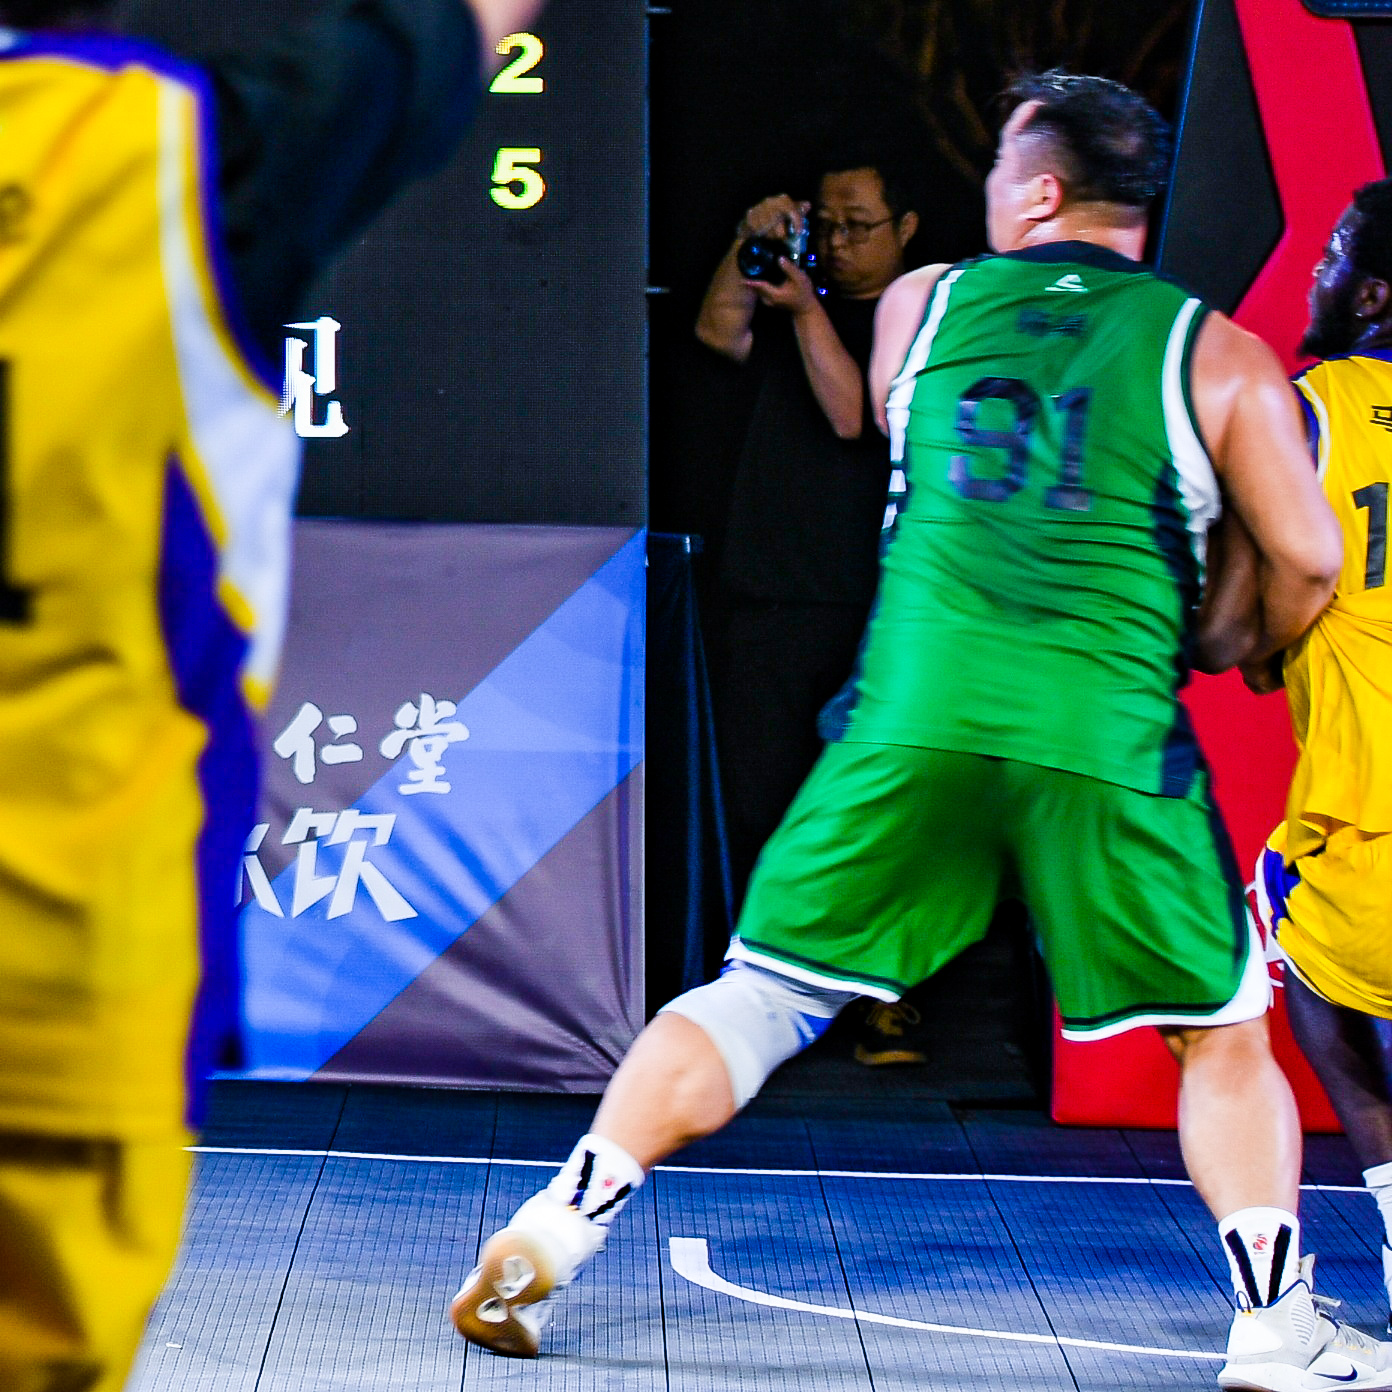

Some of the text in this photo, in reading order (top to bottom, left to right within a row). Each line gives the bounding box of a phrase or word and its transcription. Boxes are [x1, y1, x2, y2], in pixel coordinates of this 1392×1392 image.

[488, 32, 544, 94] 2
[489, 147, 546, 210] 5
[948, 376, 1093, 512] 91
[273, 692, 470, 796] 仁堂
